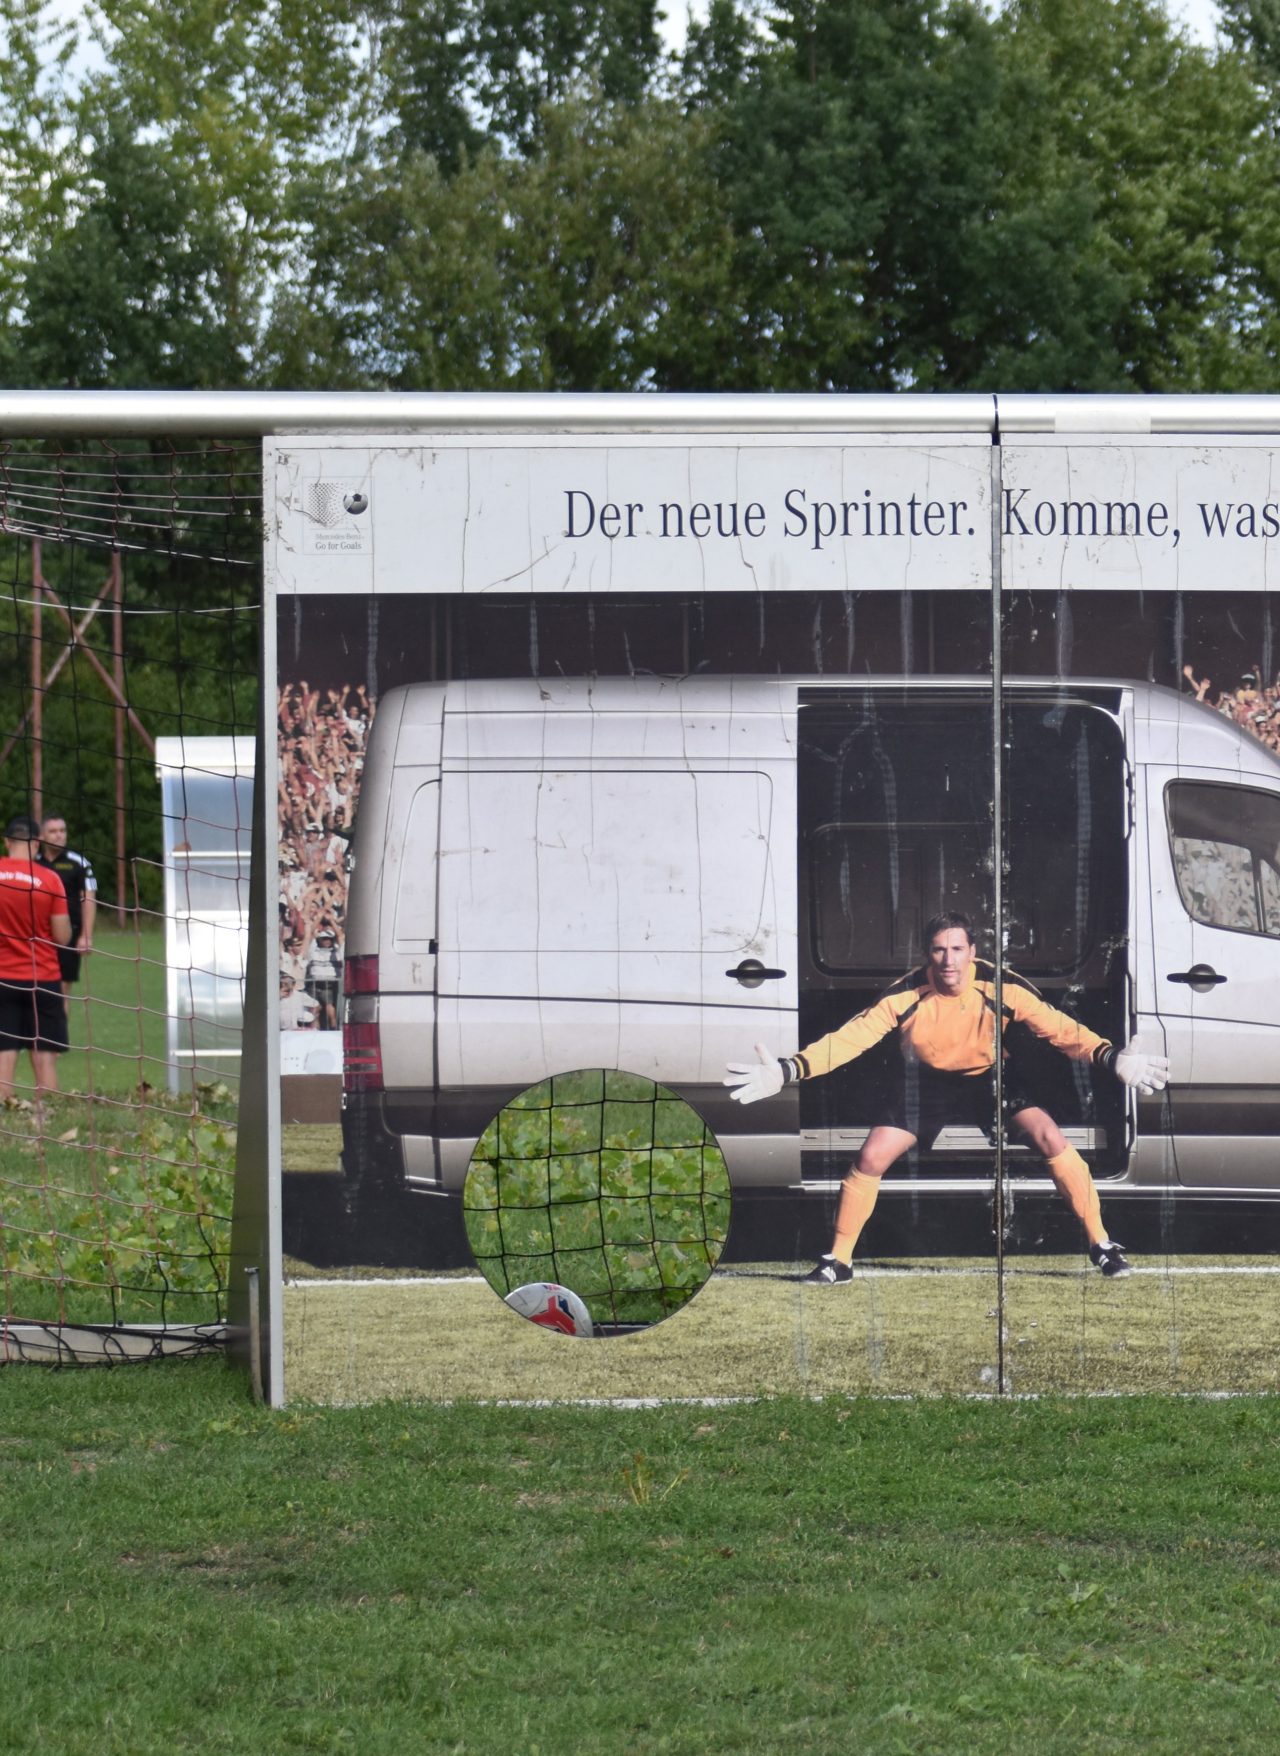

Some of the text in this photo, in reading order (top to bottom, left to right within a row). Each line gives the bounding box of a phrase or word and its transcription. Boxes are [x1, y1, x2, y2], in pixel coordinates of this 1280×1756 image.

[563, 490, 643, 538] Der
[660, 503, 767, 538] neue
[783, 489, 976, 550] Sprinter.
[1001, 488, 1182, 548] Komme,
[1197, 502, 1280, 539] was
[315, 541, 362, 550] Go for Goals
